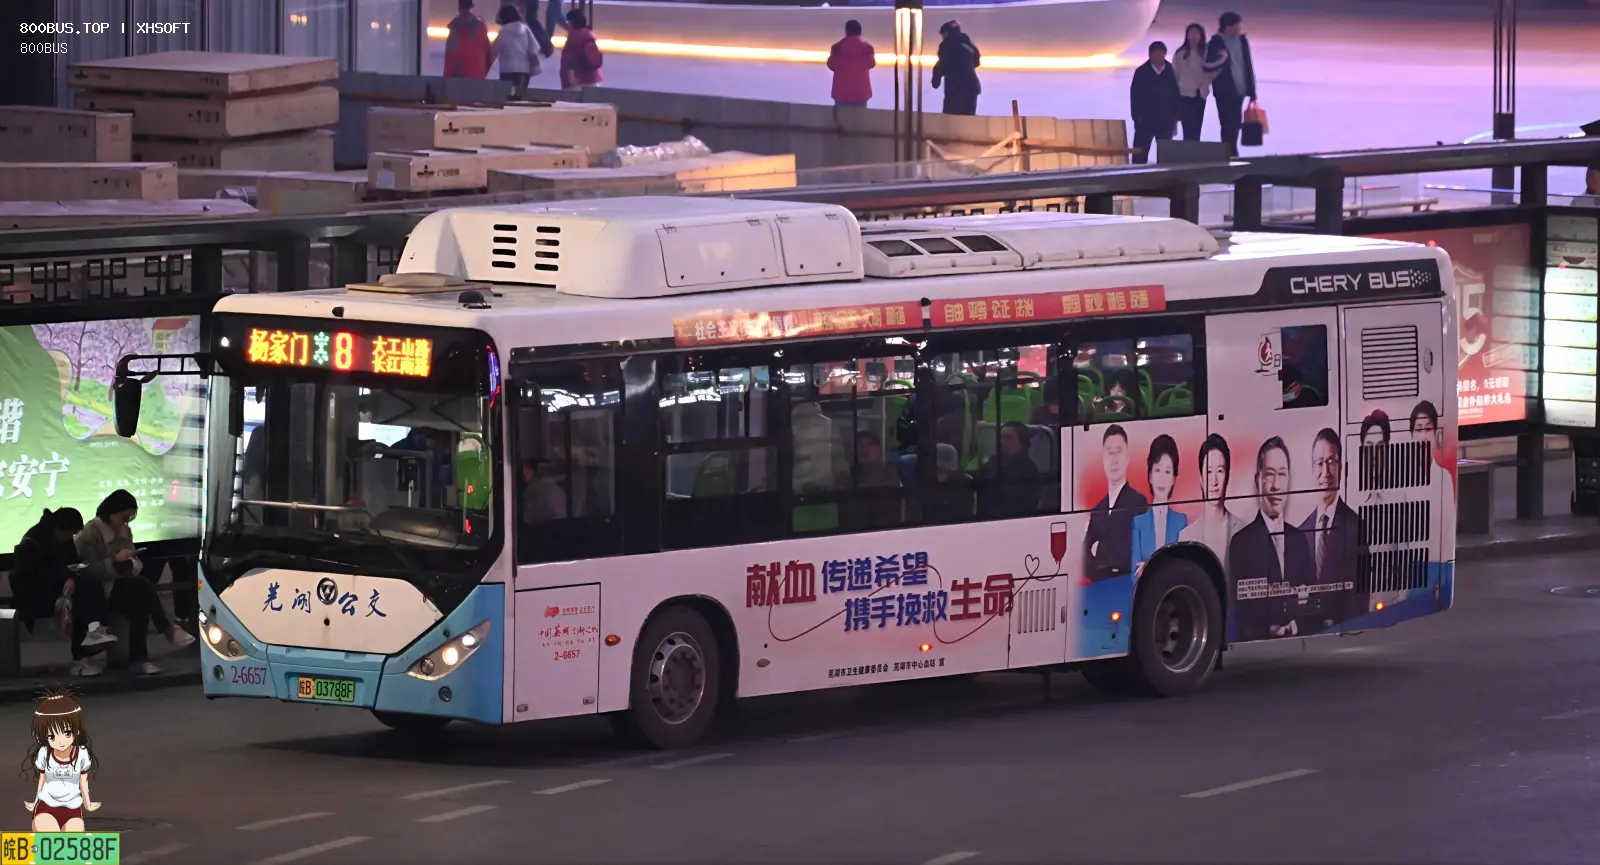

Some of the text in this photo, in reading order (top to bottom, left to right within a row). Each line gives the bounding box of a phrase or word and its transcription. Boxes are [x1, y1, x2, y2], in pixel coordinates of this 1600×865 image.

[1290, 270, 1411, 294] CHERY BUS
[944, 303, 964, 322] 自由
[968, 300, 987, 320] 平等
[992, 299, 1010, 319] 公正
[1015, 298, 1034, 317] 法治
[1106, 291, 1126, 311] 诚信
[1129, 289, 1149, 309] 友善
[249, 329, 309, 365] 杨家门
[335, 332, 353, 370] 8
[372, 335, 430, 358] 大工山路
[372, 356, 430, 376] 长江南路
[0, 451, 70, 500] 安宁
[746, 551, 928, 608] 献血 传递希望
[262, 581, 387, 617] 芜湖 公交
[950, 573, 1015, 621] 生命
[554, 649, 580, 660] 2-6657
[828, 663, 889, 679] 芜湖市卫生健康委员会
[893, 658, 936, 672] 芜湖市中心血站
[231, 665, 267, 686] 2-6657
[315, 681, 353, 698] 03788F
